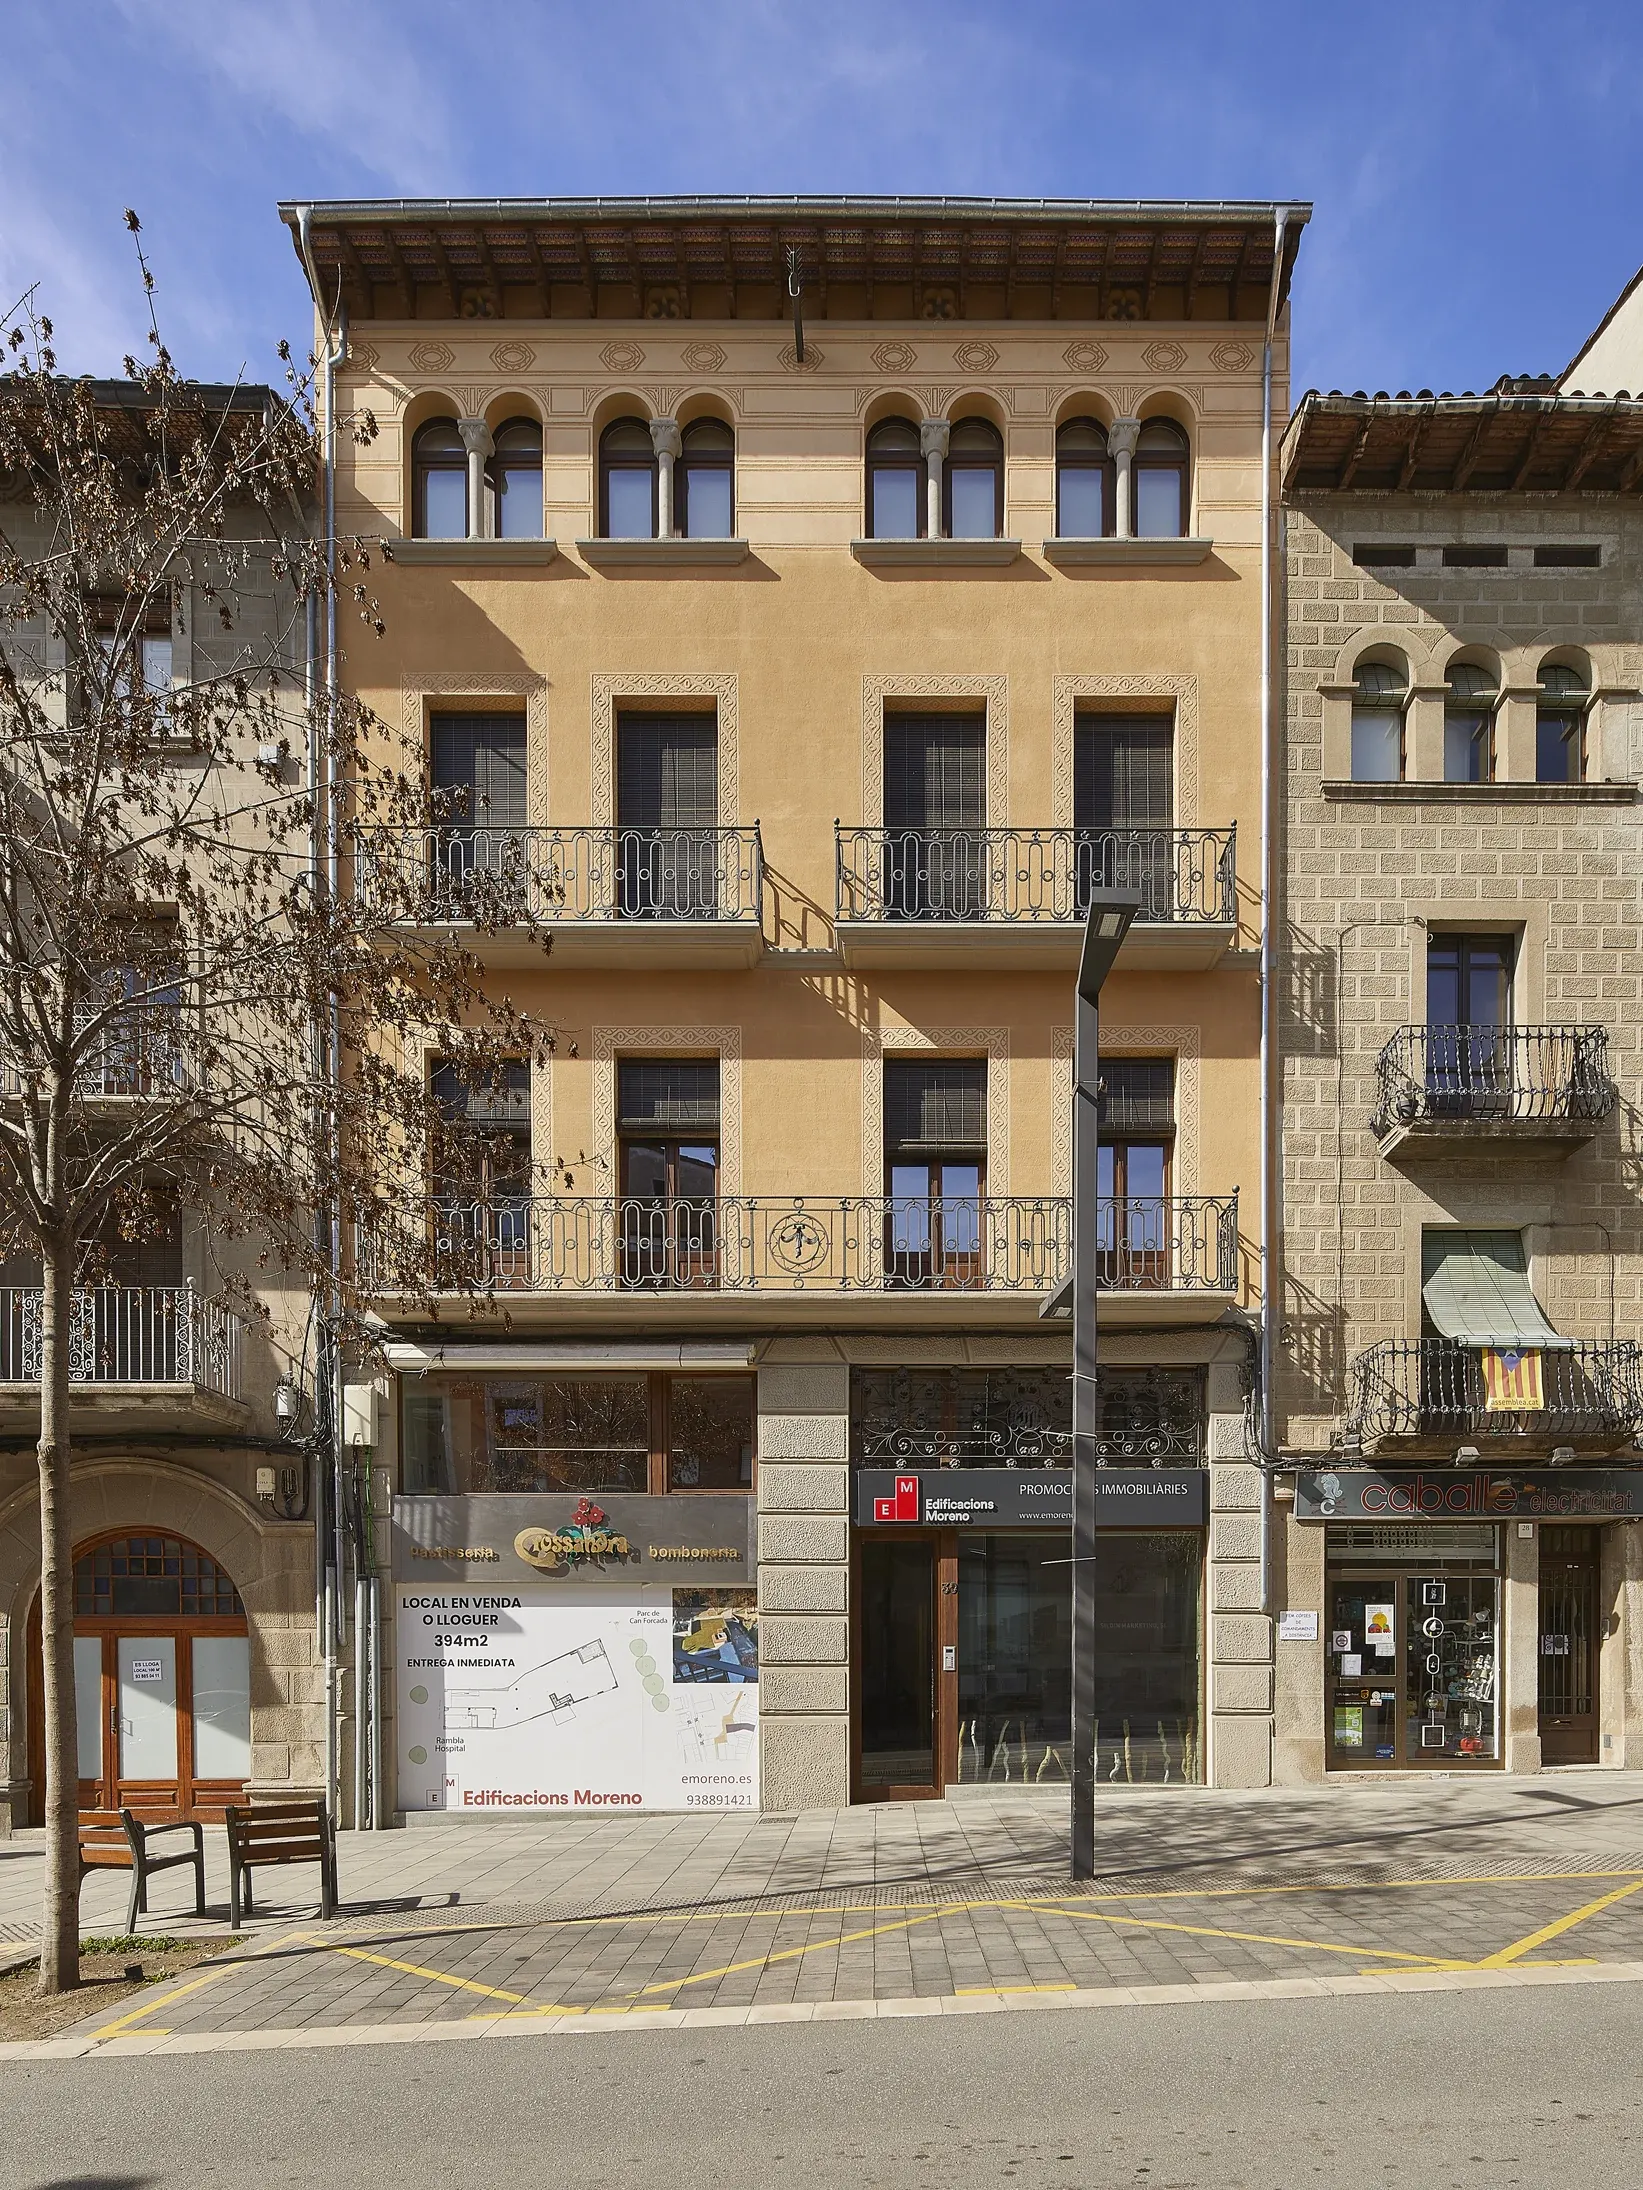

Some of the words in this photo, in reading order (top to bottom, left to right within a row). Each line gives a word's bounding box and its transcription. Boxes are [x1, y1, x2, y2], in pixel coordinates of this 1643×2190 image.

[900, 1481, 913, 1493] M
[1019, 1484, 1098, 1495] PROMOCIS
[1102, 1481, 1188, 1495] IMMOBILIÀRIES
[925, 1498, 995, 1510] Edificacions
[1529, 1487, 1633, 1511] electricitat
[881, 1504, 890, 1516] E
[925, 1510, 970, 1521] Moreno
[513, 1526, 630, 1569] Crossandra
[649, 1545, 738, 1558] bomboneria
[402, 1597, 448, 1609] LOCAL
[451, 1597, 469, 1609] EN
[472, 1597, 522, 1609] VENDA
[422, 1614, 434, 1626] O
[437, 1614, 499, 1626] LLOGUER
[434, 1635, 488, 1647] 394m2
[407, 1659, 455, 1667] ENTREGA
[457, 1659, 515, 1667] INMEDIATA
[681, 1775, 752, 1784] emoreno.es
[432, 1794, 437, 1802] E
[463, 1790, 569, 1806] Edificacions
[573, 1789, 643, 1805] Moreno
[686, 1795, 752, 1806] 938891421
